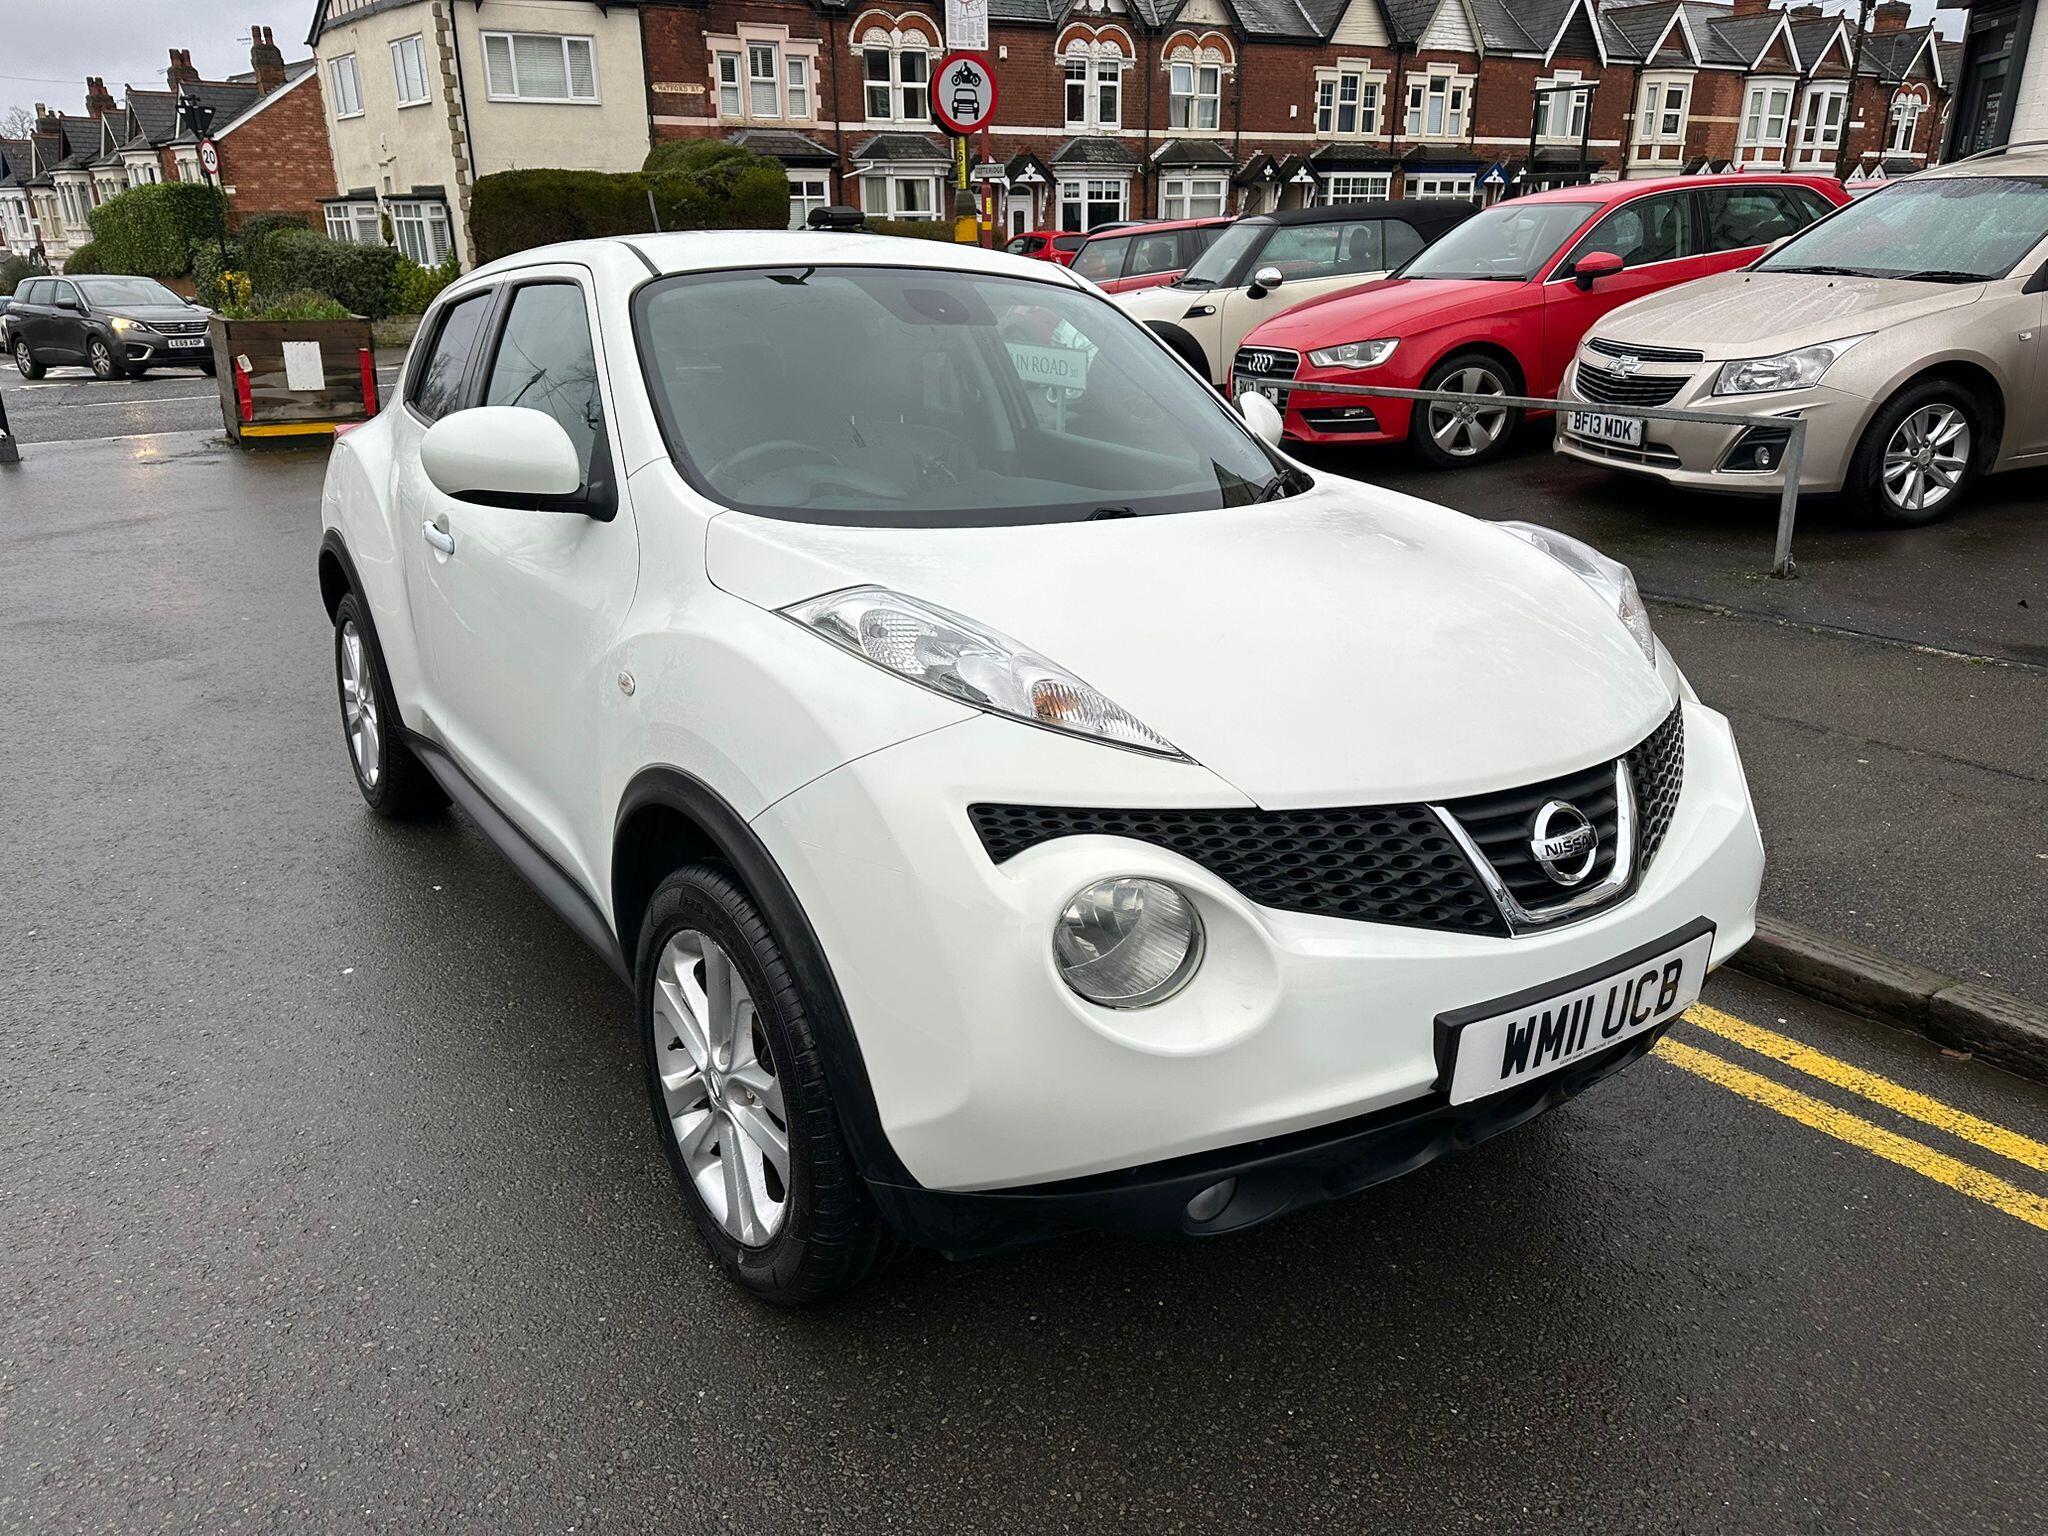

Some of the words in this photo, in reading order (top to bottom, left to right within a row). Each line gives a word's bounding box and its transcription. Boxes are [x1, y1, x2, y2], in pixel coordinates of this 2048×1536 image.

[203, 150, 216, 165] 20
[1011, 353, 1029, 371] IN
[1032, 356, 1069, 377] ROAD
[1574, 411, 1601, 434] BF13
[1604, 417, 1633, 440] MDK
[1500, 994, 1596, 1080] WM11
[1601, 957, 1683, 1039] UCB
